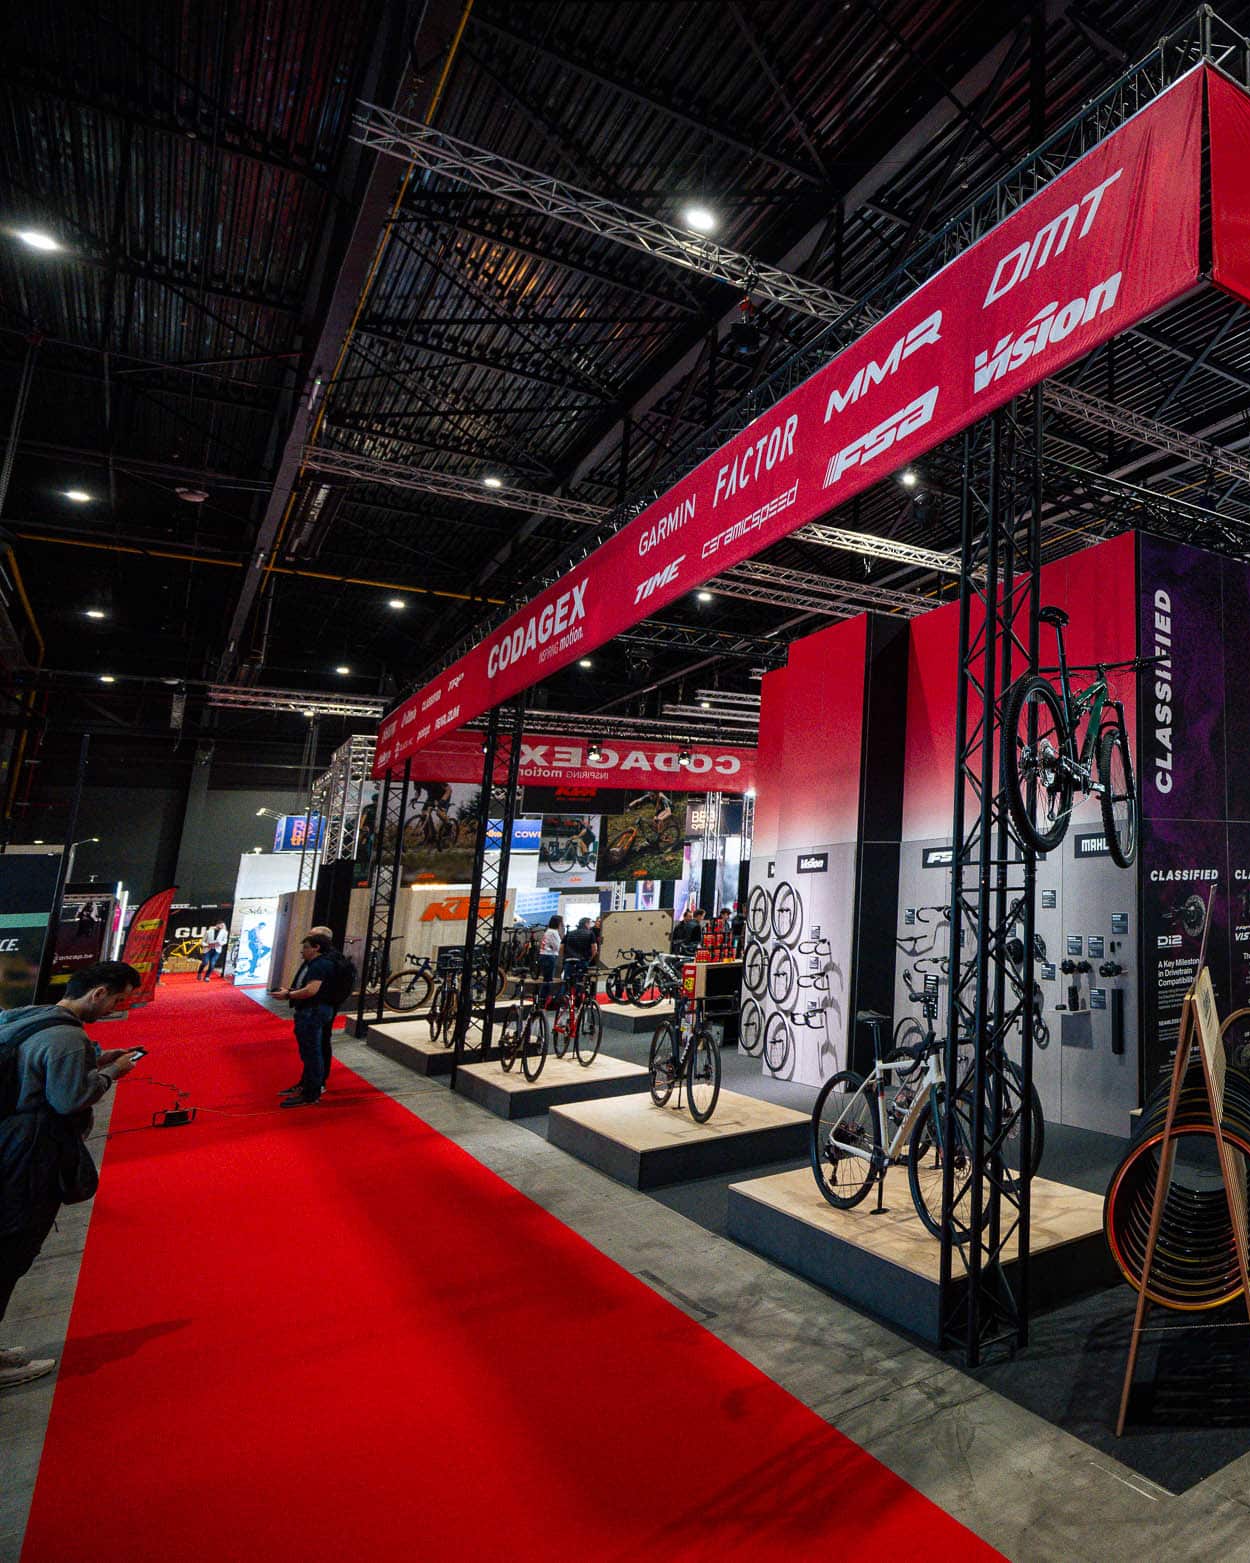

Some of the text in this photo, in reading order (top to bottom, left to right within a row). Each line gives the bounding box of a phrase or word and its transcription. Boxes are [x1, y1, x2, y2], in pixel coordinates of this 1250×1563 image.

[983, 167, 1123, 309] DMT
[824, 309, 942, 424] MMR
[974, 271, 1122, 394] Vision
[713, 414, 798, 509] FACTOR
[639, 493, 696, 556] GARMIN
[634, 555, 686, 605] TIME
[487, 577, 589, 679] CODAGEX
[1154, 589, 1173, 794] CLASSIFIED
[1081, 839, 1110, 853] MAHL
[1150, 869, 1219, 881] CLASSIFIED
[1158, 976, 1195, 987] Compatibilit
[1175, 958, 1200, 967] Mileston
